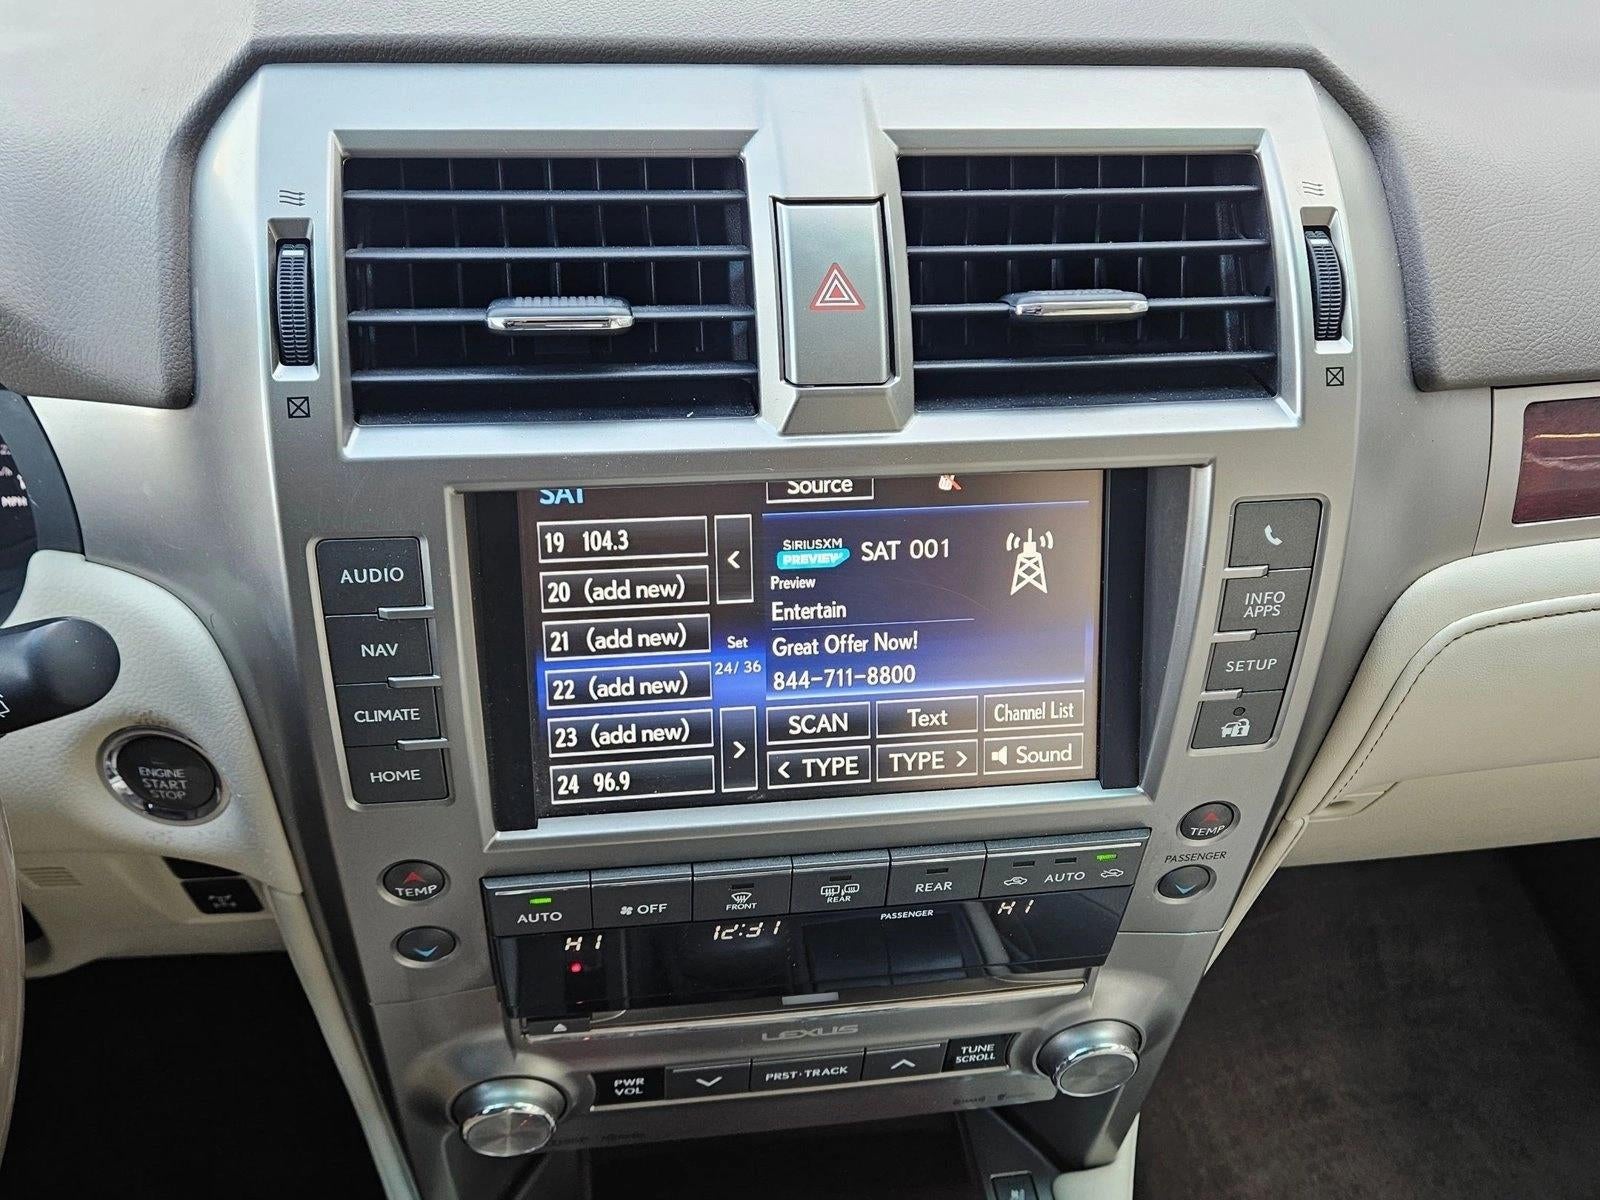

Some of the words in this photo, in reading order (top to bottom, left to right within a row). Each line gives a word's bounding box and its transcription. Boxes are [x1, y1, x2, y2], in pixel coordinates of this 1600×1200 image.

[787, 478, 853, 494] Source
[545, 532, 565, 553] 19
[582, 530, 629, 551] 104.3
[861, 541, 901, 562] SAT
[909, 538, 950, 559] 001
[782, 552, 843, 565] PREVIEW
[340, 567, 405, 584] AUDIO
[770, 576, 816, 590] Preview
[547, 582, 571, 602] 20
[584, 577, 633, 603] (add
[635, 573, 686, 599] new)
[1244, 590, 1286, 605] INFO
[771, 601, 847, 622] Entertain
[1243, 604, 1282, 618] APPS
[549, 631, 569, 652] 21
[586, 626, 633, 652] (add
[637, 622, 688, 648] new)
[727, 635, 749, 650] Set
[772, 637, 819, 657] Great
[824, 633, 869, 654] Offer
[874, 630, 919, 651] Now!
[360, 643, 399, 658] NAV
[743, 660, 763, 674] 36
[1225, 657, 1278, 673] SETUP
[773, 664, 916, 691] 844-711-8800
[552, 680, 576, 701] 22
[588, 675, 638, 700] (add
[640, 671, 690, 696] new)
[353, 708, 421, 724] CLIMATE
[907, 708, 949, 728] Text
[994, 703, 1046, 723] Channel
[1050, 701, 1075, 721] List
[788, 713, 849, 735] SCAN
[554, 727, 579, 748] 23
[590, 722, 639, 748] (add
[641, 718, 691, 743] new)
[1016, 743, 1073, 764] Sound
[802, 755, 860, 779] TYPE
[889, 750, 946, 773] TYPE
[138, 767, 186, 778] ENGINE
[369, 768, 422, 784] HOME
[142, 778, 188, 789] START
[557, 773, 580, 795] 24
[592, 771, 631, 792] 96.9
[149, 789, 187, 800] STOP
[1190, 825, 1226, 836] TEMP
[1164, 850, 1227, 864] PASSENGER
[1044, 870, 1086, 884] AUTO
[395, 884, 438, 898] TEMP
[915, 880, 953, 895] REAR
[725, 901, 758, 912] FRONT
[826, 894, 852, 905] REAR
[637, 903, 668, 915] OFF
[880, 908, 934, 921] PASSENGER
[517, 911, 563, 924] AUTO
[761, 1024, 859, 1041] LEXUS
[961, 1044, 995, 1055] TUNE
[955, 1053, 997, 1065] SCROLL
[613, 1077, 645, 1088] PWR
[614, 1086, 644, 1097] VOL
